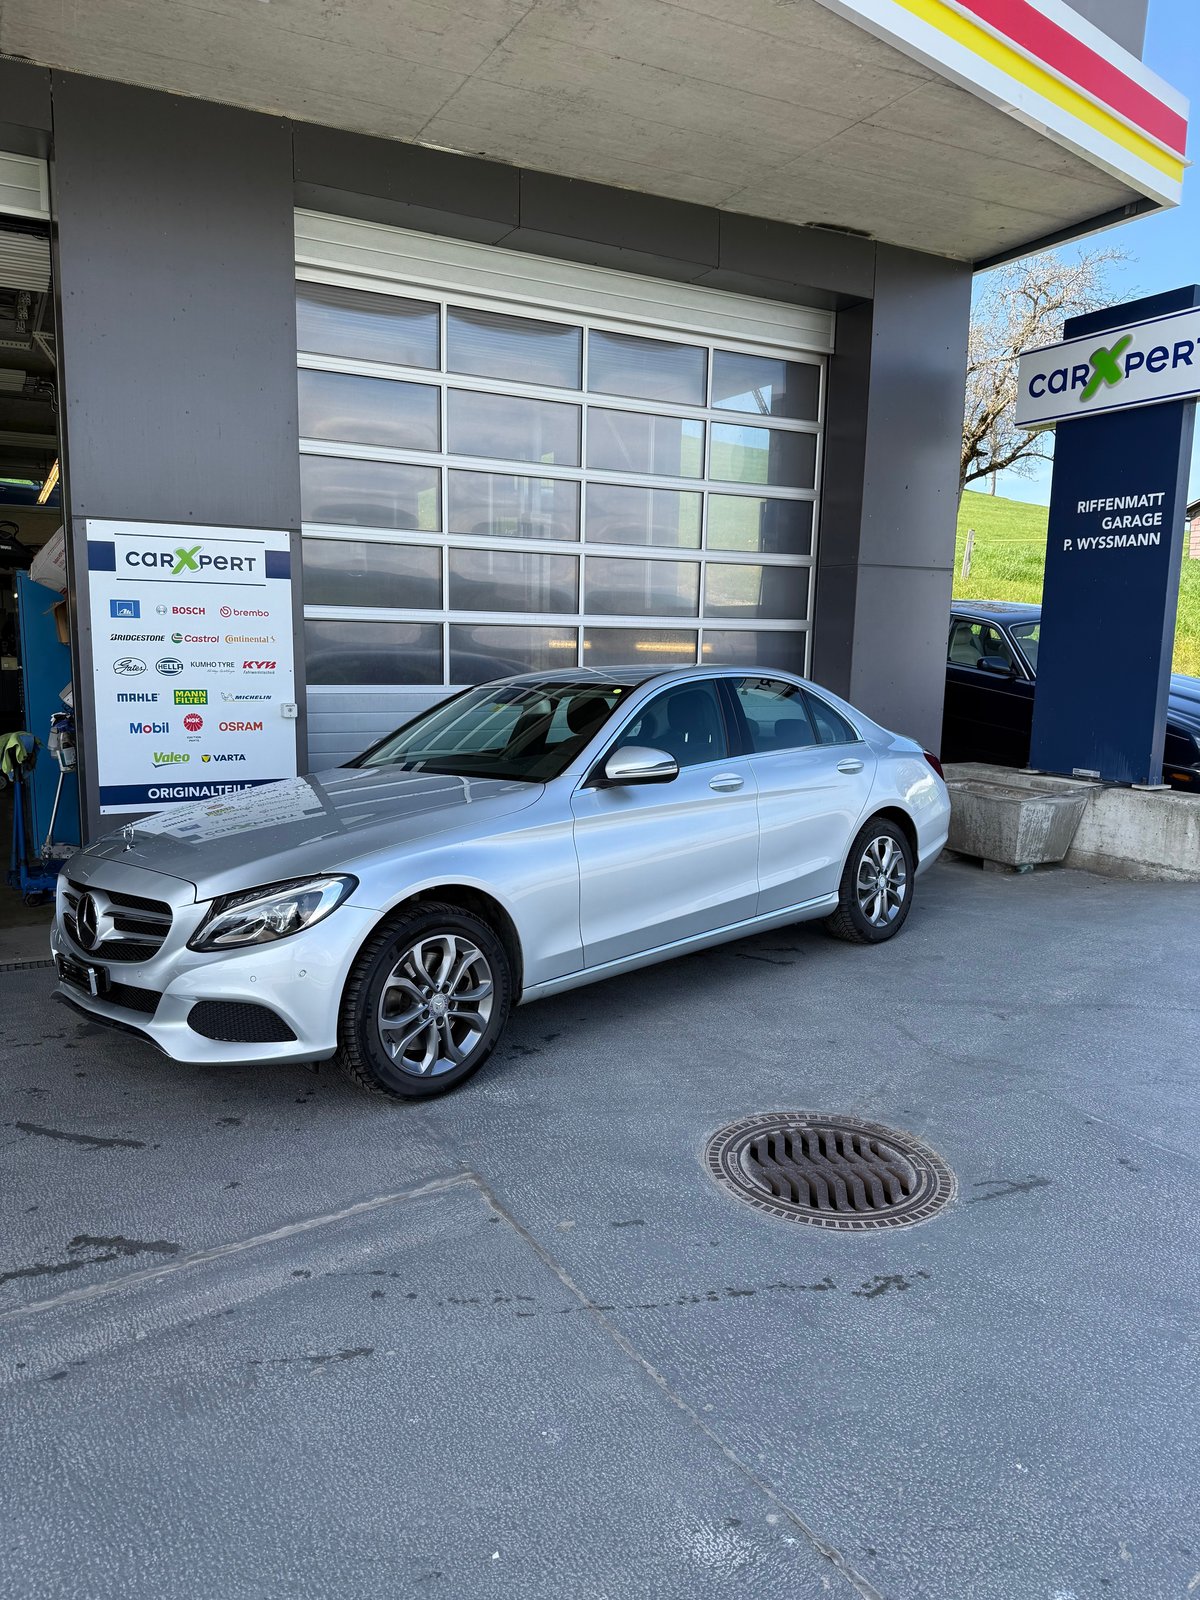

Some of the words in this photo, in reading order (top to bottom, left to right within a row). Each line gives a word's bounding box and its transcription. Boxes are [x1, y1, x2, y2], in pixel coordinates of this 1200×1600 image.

[1028, 333, 1200, 403] carXper
[1077, 492, 1165, 514] RIFFENMATT
[1102, 512, 1162, 530] GARAGE
[1064, 538, 1073, 551] P.
[1077, 532, 1161, 551] WYSSMANN
[172, 606, 206, 616] BOSCH
[234, 608, 270, 618] brembo
[110, 633, 165, 642] BRIDGESTONE
[184, 634, 220, 643] Castrol
[224, 634, 269, 644] Continental
[116, 659, 145, 674] Gates
[158, 663, 184, 671] HELLA
[242, 660, 277, 669] KYB
[117, 693, 158, 703] MAHLE
[129, 722, 169, 734] Mobil
[218, 721, 263, 732] OSRAM
[153, 752, 191, 764] Valeo
[213, 753, 246, 762] VARTA
